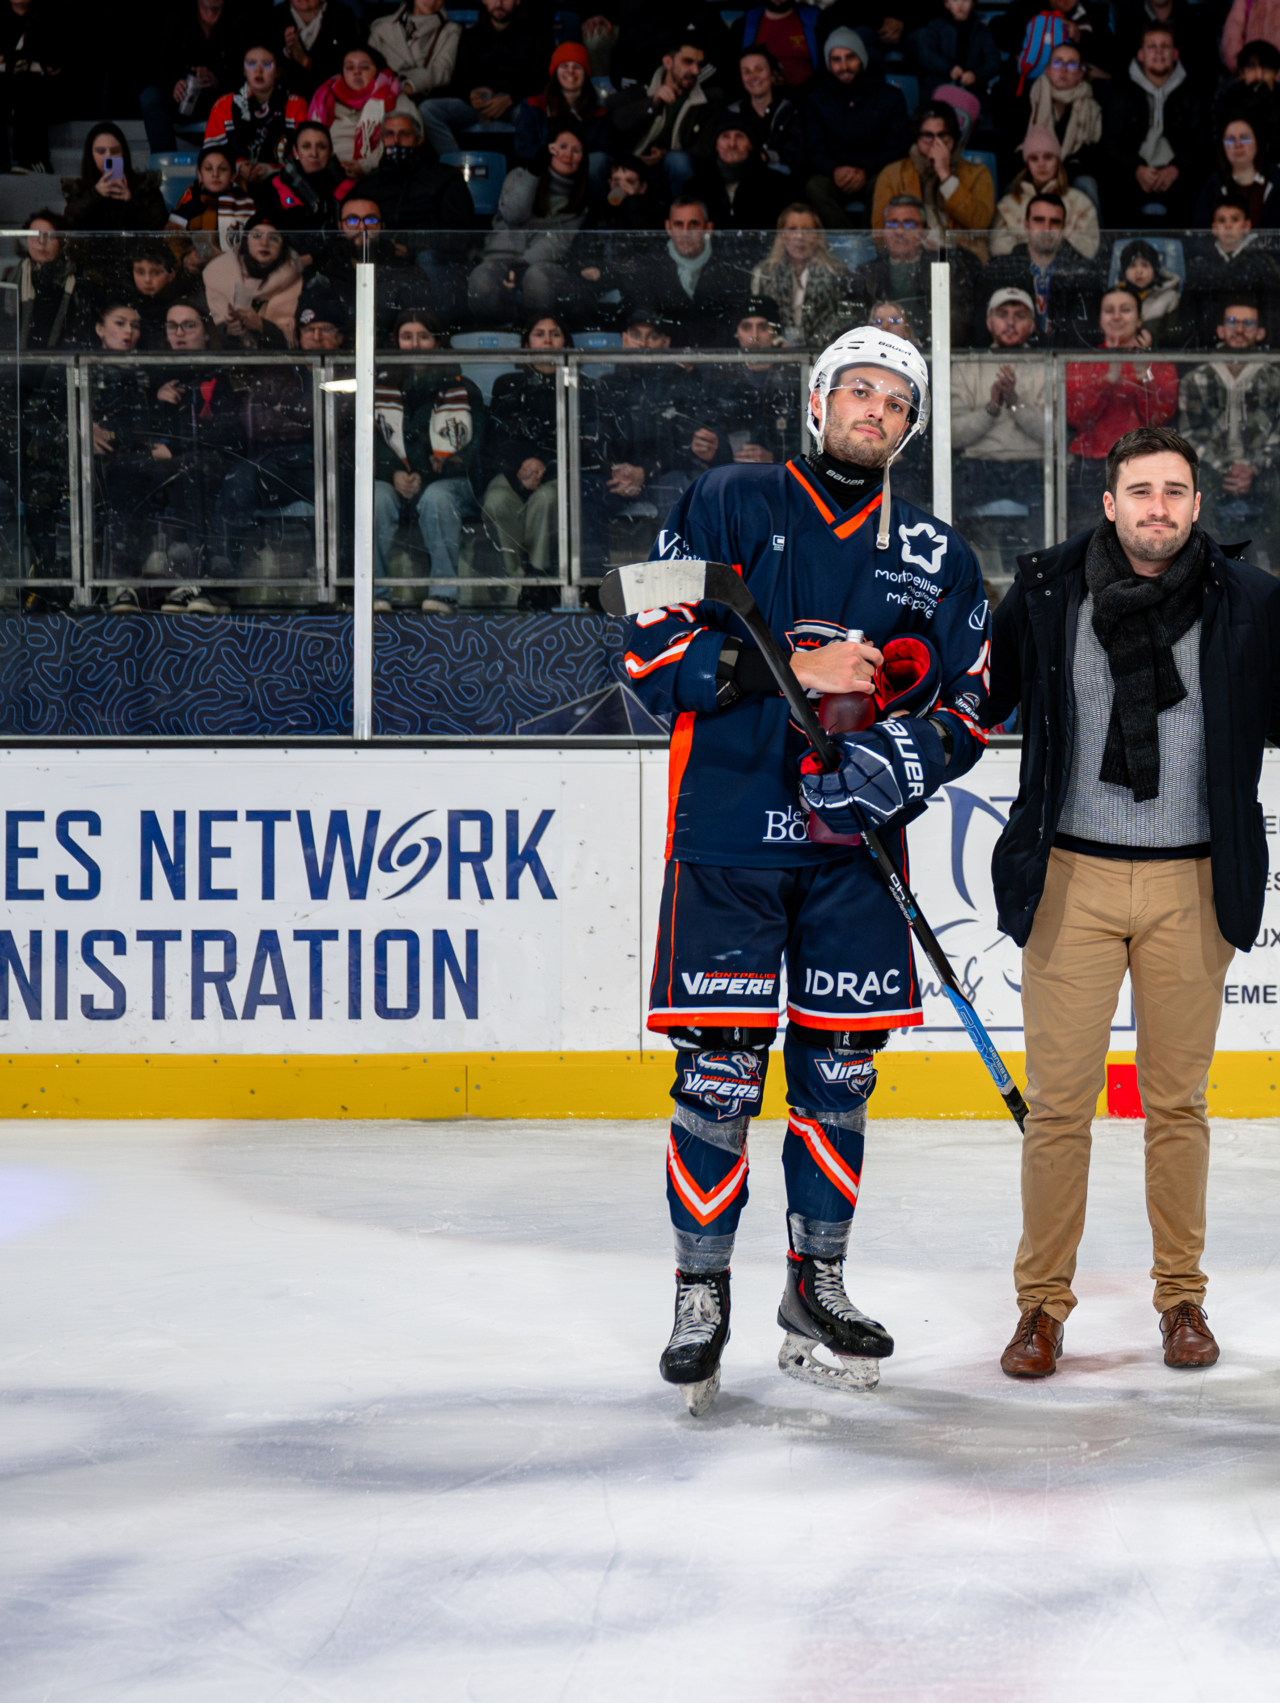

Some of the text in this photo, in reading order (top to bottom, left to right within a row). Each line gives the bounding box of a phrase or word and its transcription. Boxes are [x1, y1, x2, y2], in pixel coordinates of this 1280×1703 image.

[878, 340, 912, 356] BAUER
[826, 469, 865, 486] BAUER
[877, 719, 925, 799] AUER
[5, 809, 558, 901] ES NETWORK
[0, 929, 480, 1021] NISTRATION
[681, 971, 775, 995] VIPERS
[804, 967, 901, 1006] IDRAC
[685, 1072, 759, 1099] VIPERS
